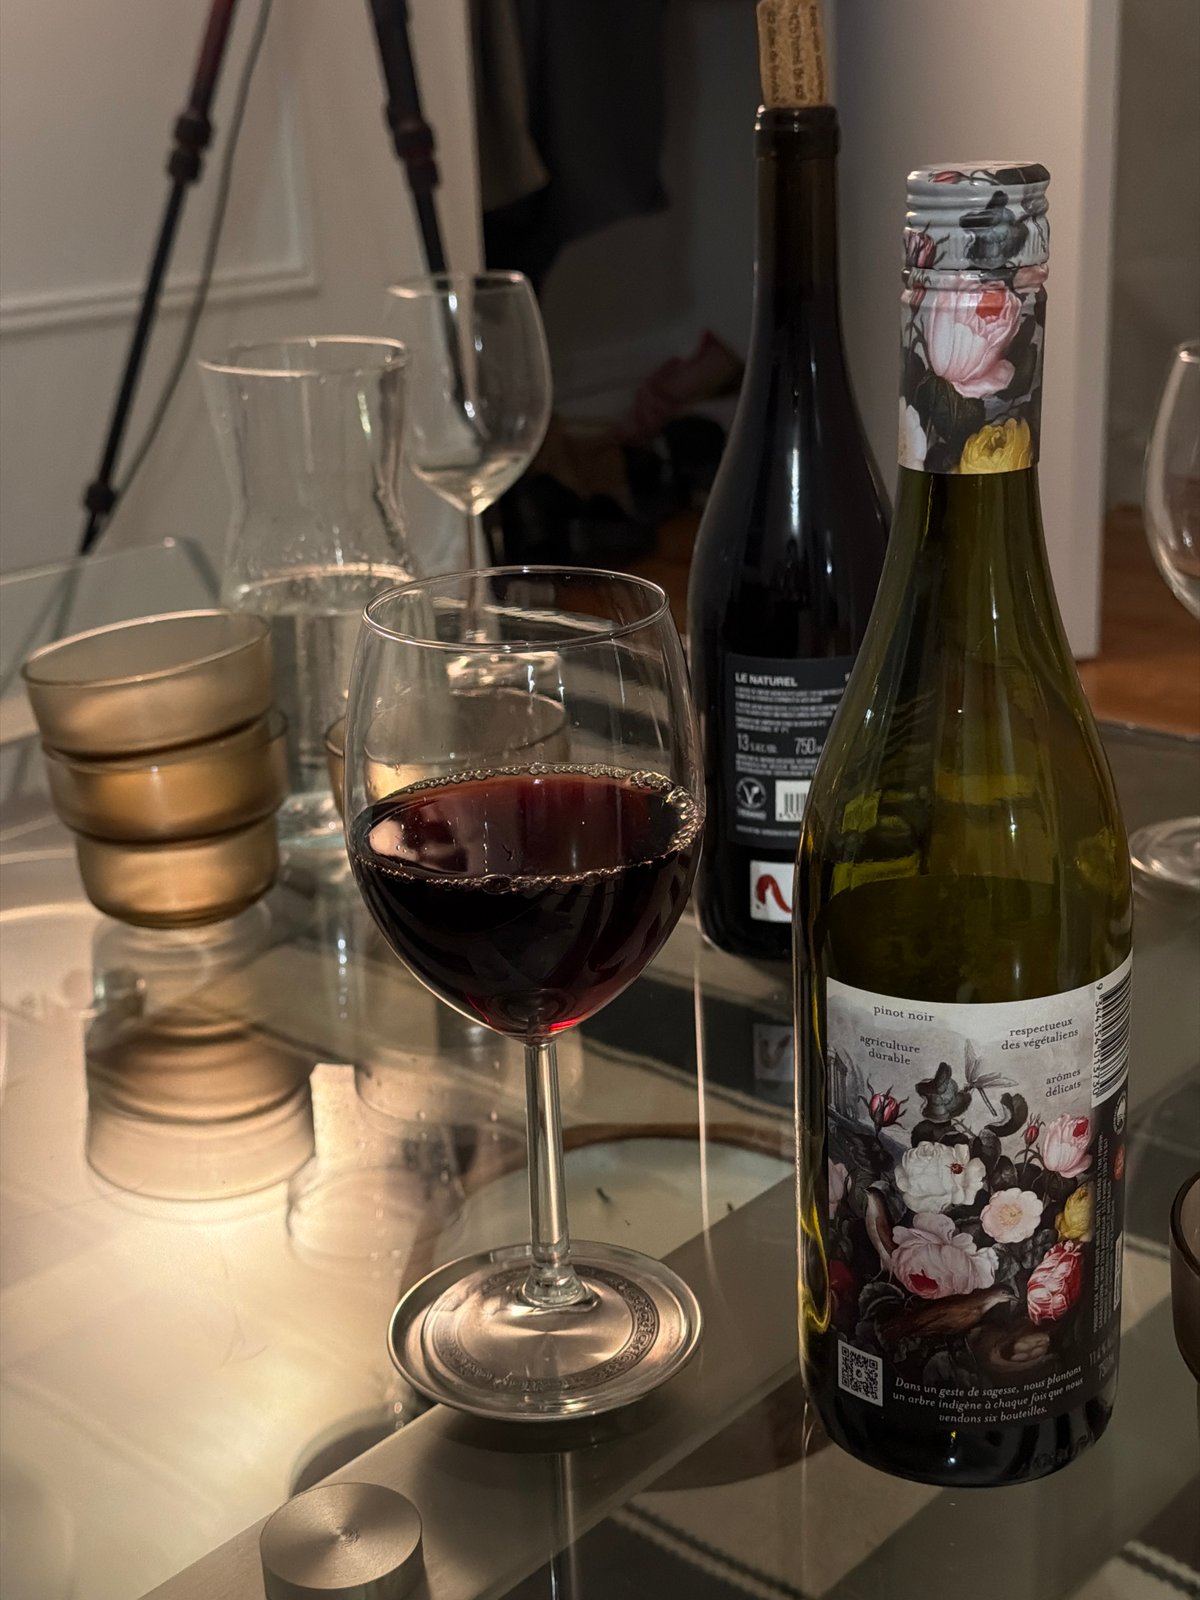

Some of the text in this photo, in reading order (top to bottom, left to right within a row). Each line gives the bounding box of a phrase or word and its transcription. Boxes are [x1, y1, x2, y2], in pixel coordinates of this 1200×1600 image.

[735, 672, 798, 687] LE NATUREL
[737, 733, 750, 752] 13
[795, 737, 817, 755] 750
[1096, 982, 1104, 990] 9
[873, 1005, 935, 1021] pinot noir
[1009, 1018, 1073, 1038] respectueux
[860, 1034, 921, 1054] agriculture
[1001, 1028, 1079, 1051] des végétaliens
[868, 1047, 911, 1066] durable
[1045, 1068, 1081, 1085] arômes
[1045, 1080, 1082, 1098] délicats
[895, 1376, 921, 1392] Dans
[923, 1385, 937, 1394] un
[938, 1387, 965, 1398] geste
[967, 1386, 980, 1397] de
[1023, 1380, 1046, 1392] nous
[1046, 1365, 1082, 1389] plantons
[892, 1377, 1084, 1413] un arbre indigène à chaque fois que nous
[938, 1405, 1048, 1424] vendons six bouteilles.
